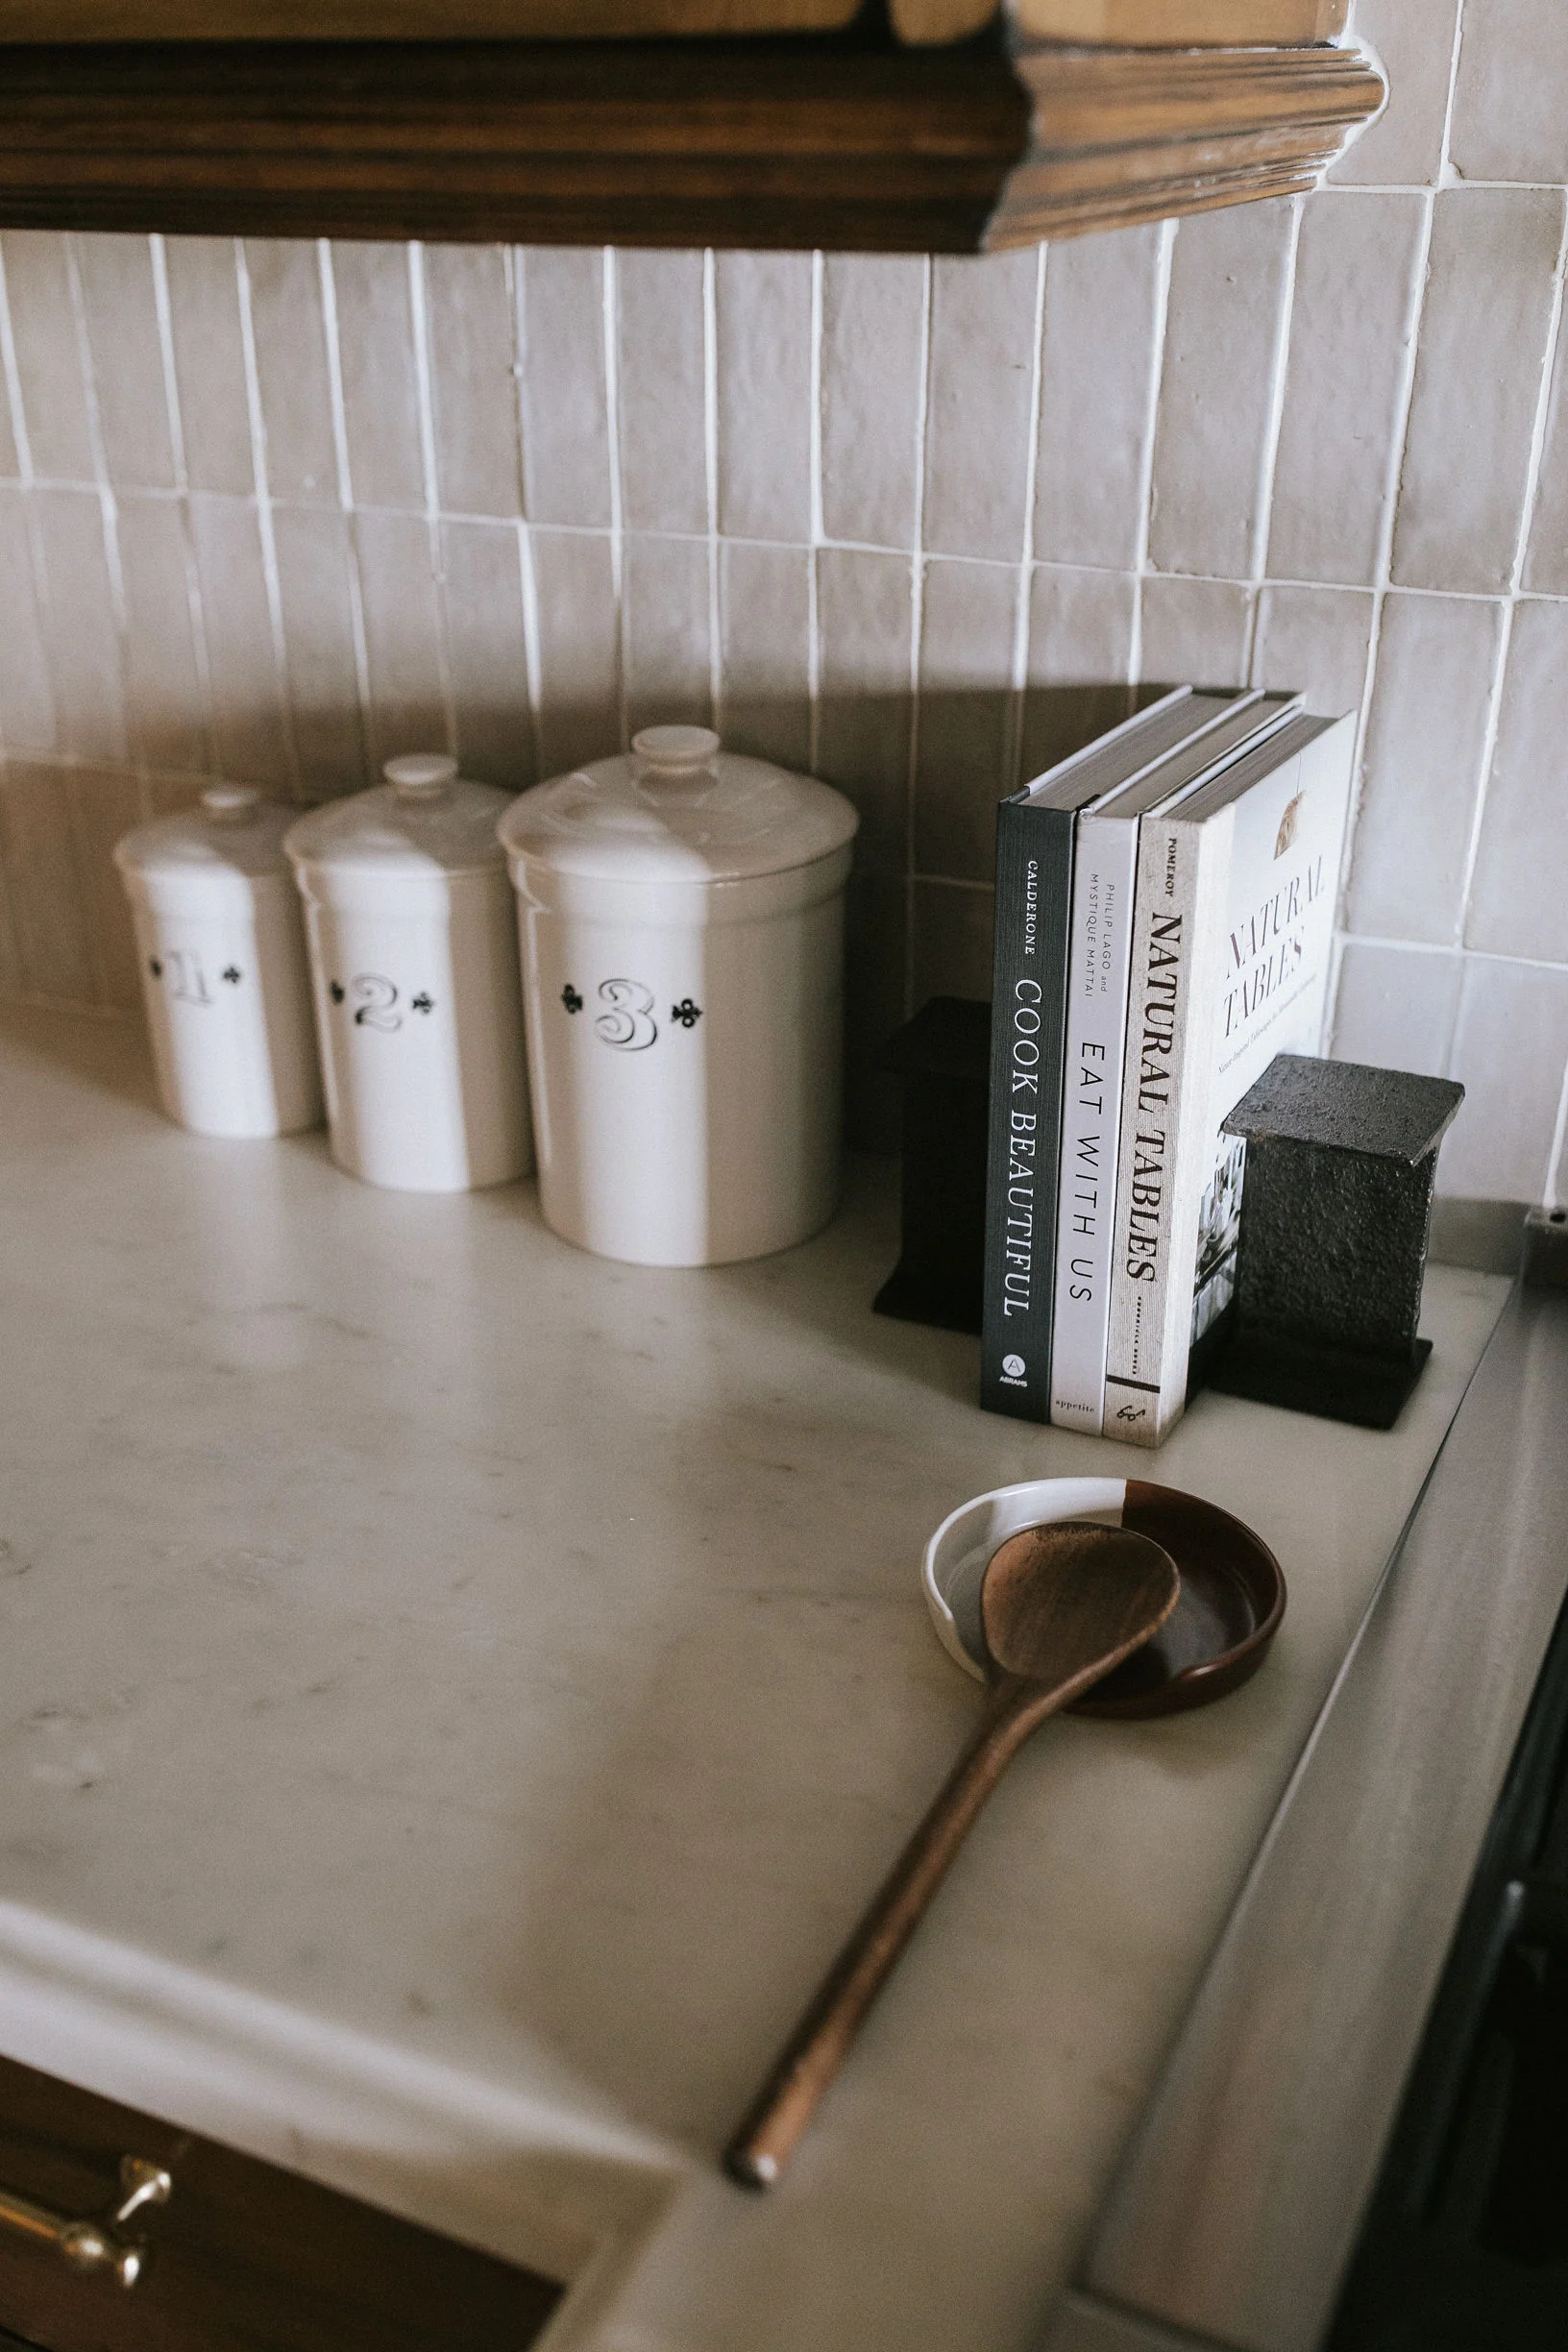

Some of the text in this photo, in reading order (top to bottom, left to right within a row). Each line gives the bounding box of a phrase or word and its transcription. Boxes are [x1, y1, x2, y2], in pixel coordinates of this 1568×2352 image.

[1164, 838, 1177, 897] POMEROY
[1024, 860, 1039, 955] CALDERONE
[1085, 873, 1099, 997] MYSTIQUE MATTAI
[1103, 884, 1115, 928] PHILIP
[1226, 856, 1324, 980] NATURAL
[166, 948, 214, 1007] 1
[1102, 934, 1112, 969] LAGO
[1224, 925, 1305, 1038] TABLES
[350, 971, 403, 1033] 2
[595, 978, 658, 1052] 3
[1126, 912, 1183, 1284] NATURAL TABLES
[1004, 979, 1042, 1316] COOK BEAUTIFUL
[1069, 1041, 1105, 1302] EAT WITH US
[999, 1376, 1028, 1388] ABRAMS
[1055, 1399, 1094, 1413] appetite
